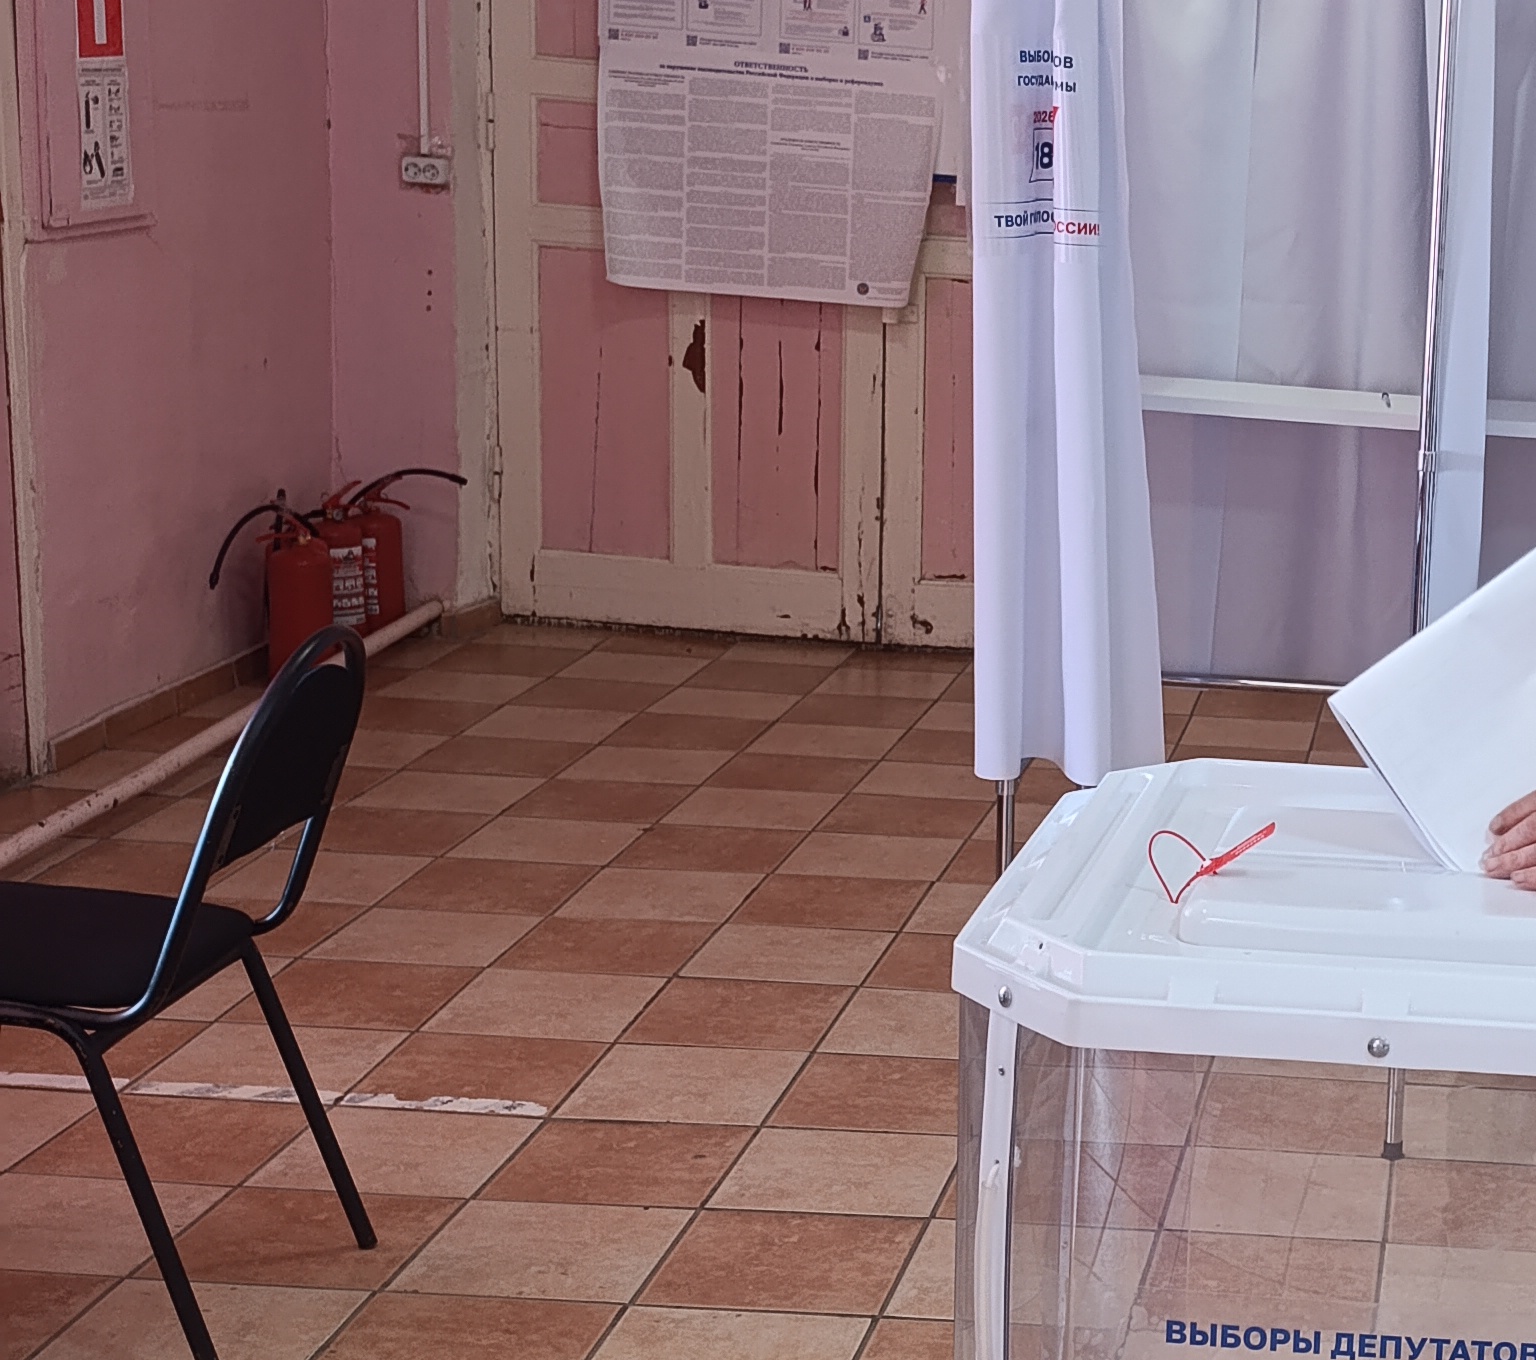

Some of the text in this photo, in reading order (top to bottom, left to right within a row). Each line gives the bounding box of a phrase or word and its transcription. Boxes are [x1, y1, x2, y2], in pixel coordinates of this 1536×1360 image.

[1035, 141, 1054, 170] 18
[994, 210, 1028, 228] ТВОЙ
[1166, 1320, 1321, 1355] ВЫБОРЫ
